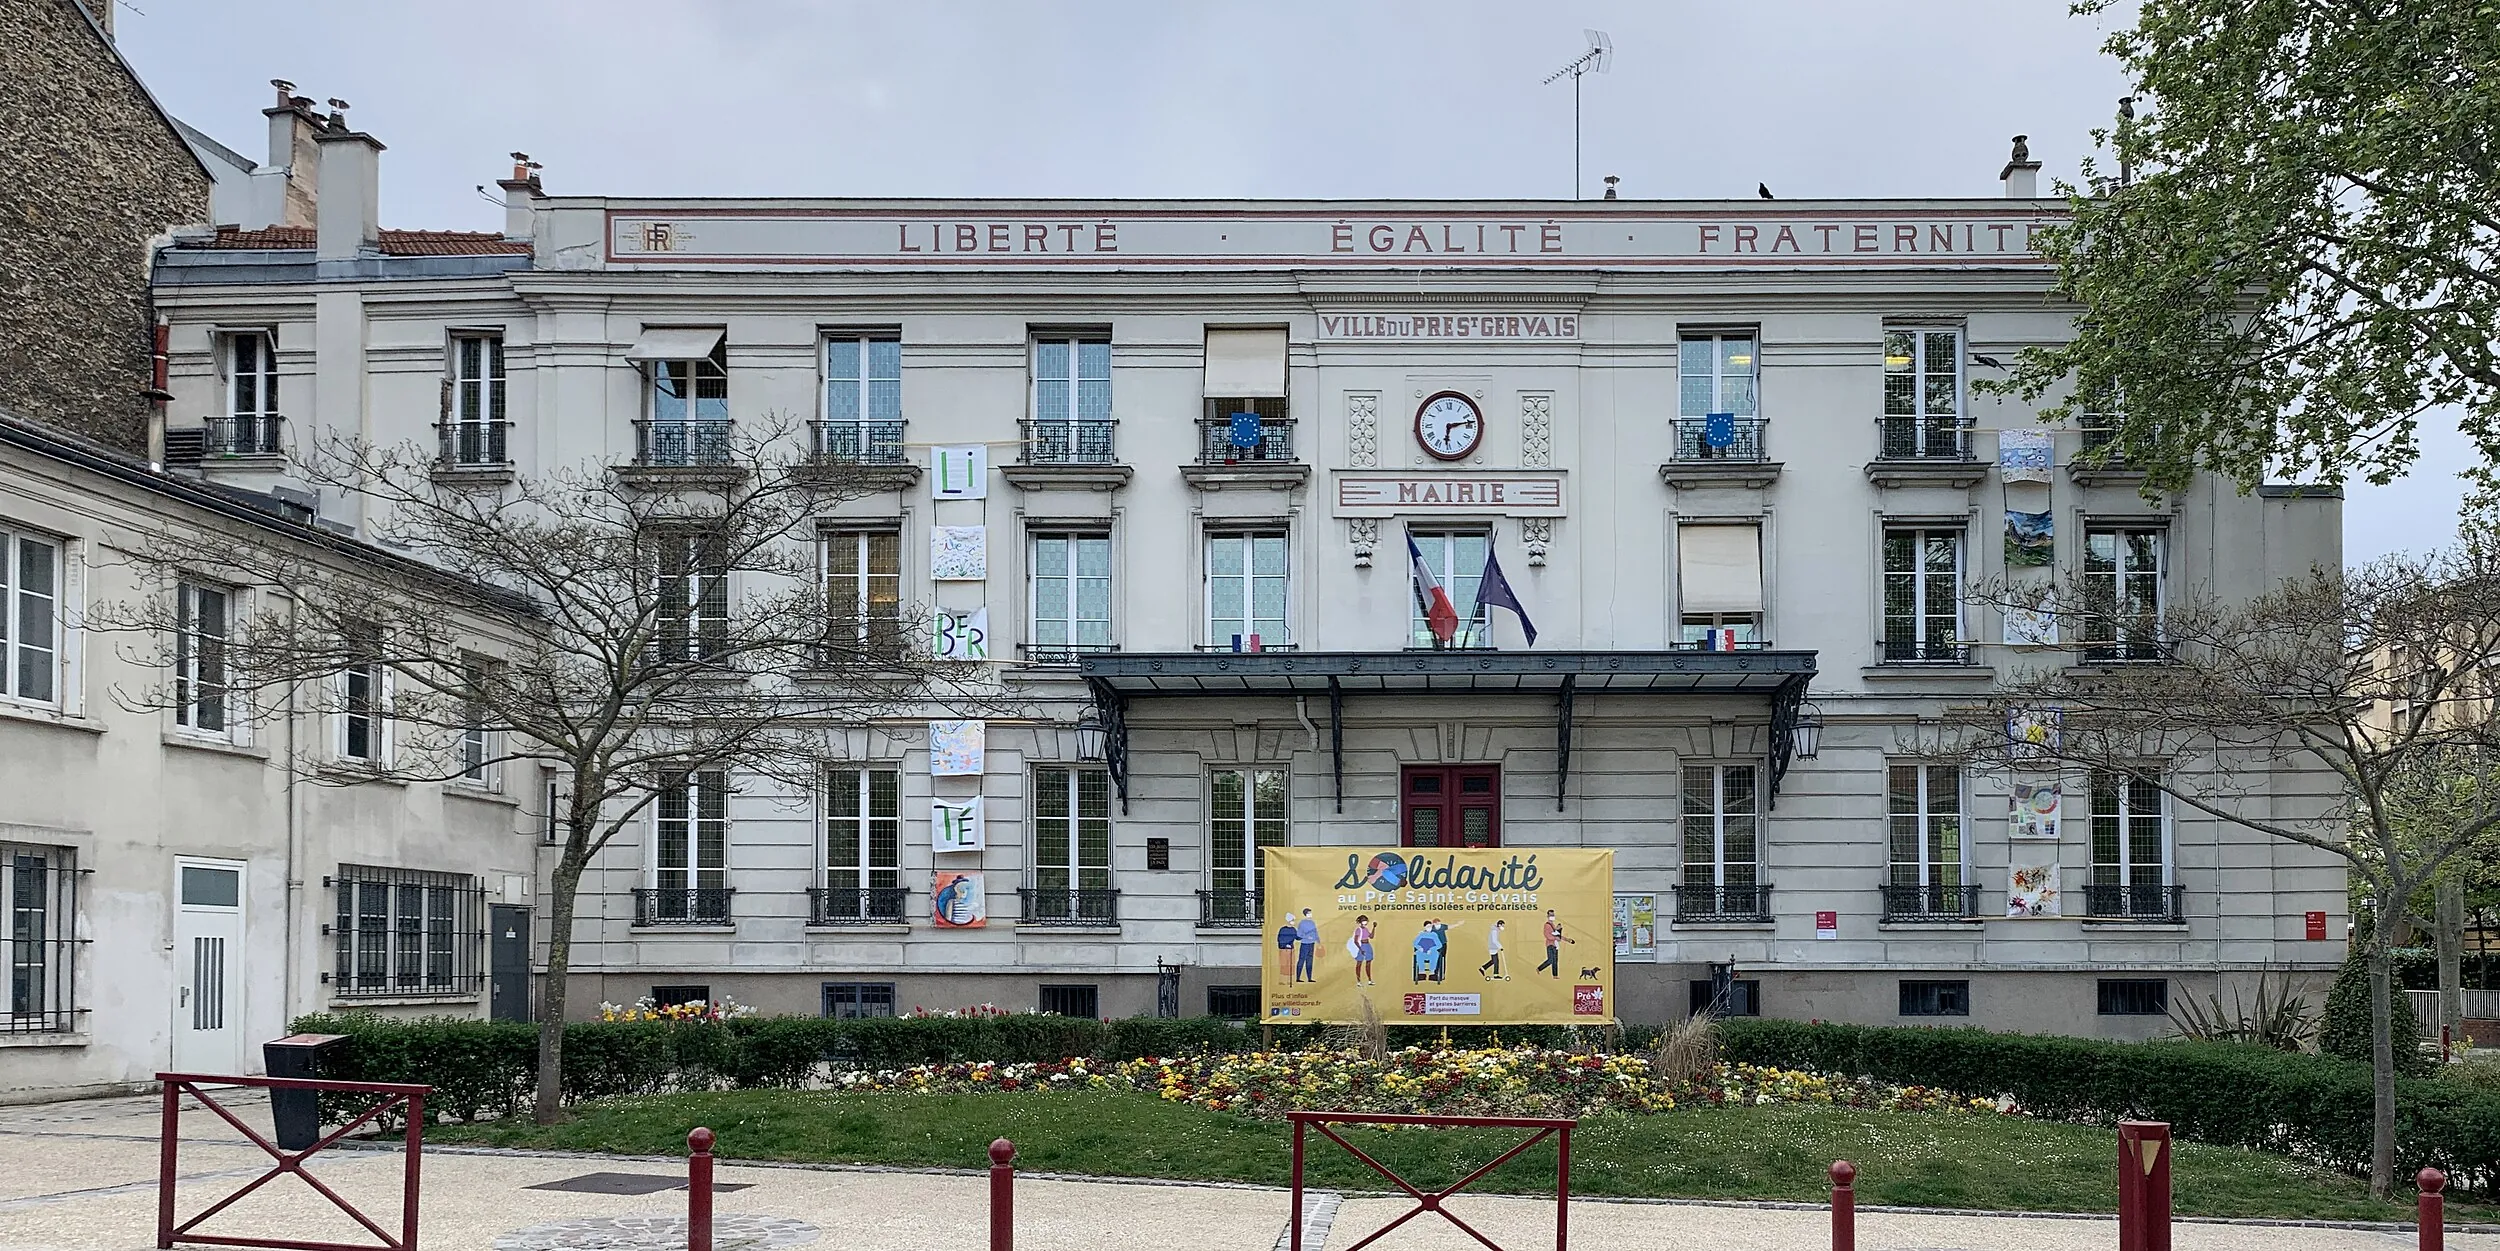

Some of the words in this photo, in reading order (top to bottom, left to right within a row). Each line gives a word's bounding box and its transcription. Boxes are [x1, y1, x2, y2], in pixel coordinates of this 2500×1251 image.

[899, 218, 1118, 252] LIBERTÉ
[1331, 218, 1563, 253] ÉGALITÉ
[1322, 316, 1386, 336] VILLE
[1387, 320, 1411, 336] DU
[1480, 316, 1576, 336] GERVAIS
[1398, 483, 1504, 503] MAIRIE
[935, 613, 987, 657] BER
[934, 805, 976, 846] TÉ
[1337, 894, 1357, 903] au
[1365, 889, 1397, 903] Pré
[1405, 890, 1538, 903] Saint-Gervais
[1359, 903, 1372, 911] les
[1374, 903, 1426, 912] personnes
[1429, 902, 1464, 911] isolées
[1466, 903, 1475, 911] et
[1477, 902, 1538, 912] précarisées
[1576, 992, 1592, 1000] Pré
